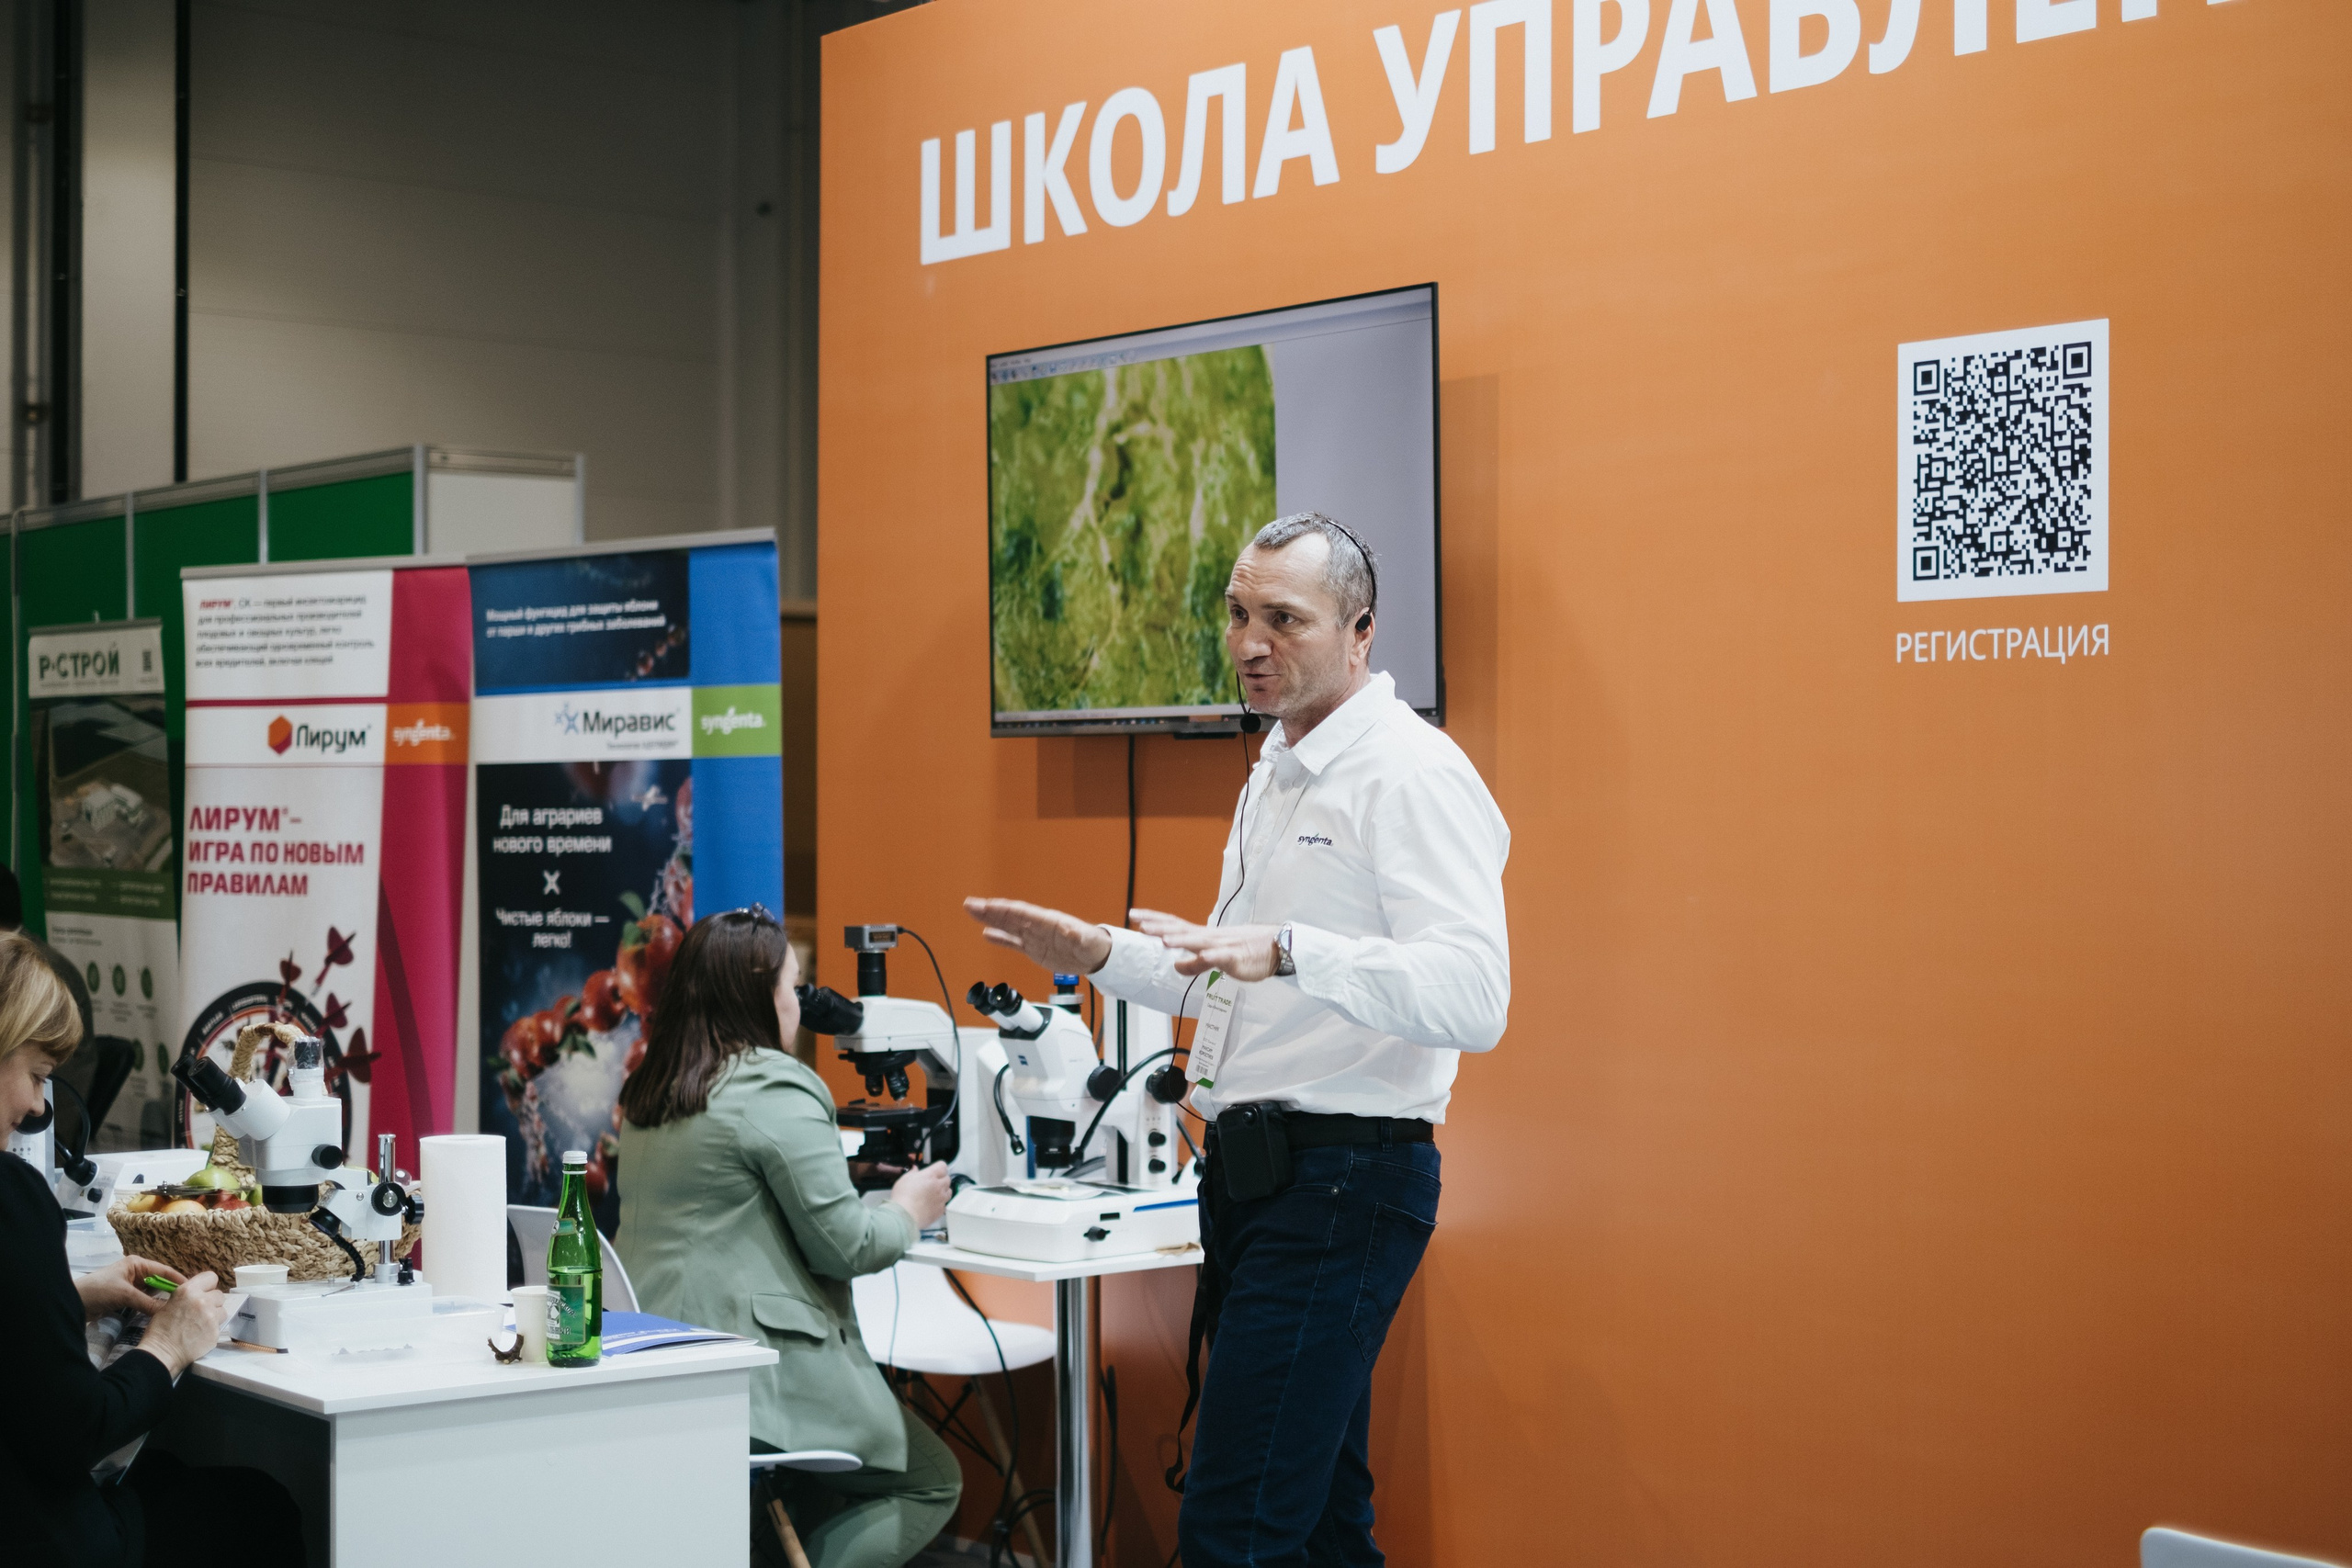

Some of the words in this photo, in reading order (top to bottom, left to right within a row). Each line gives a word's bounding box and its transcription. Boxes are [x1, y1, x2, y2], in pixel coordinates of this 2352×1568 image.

[921, 45, 1340, 265] ШКОЛА
[1373, 0, 2253, 175] УПРАВ
[1896, 624, 2109, 664] РЕГИСТРАЦИЯ
[499, 804, 529, 829] Для
[533, 807, 603, 829] аграриев
[492, 837, 544, 853] нового
[547, 836, 613, 857] времени
[1297, 833, 1333, 846] syngenta
[188, 841, 244, 863] ИГРА
[250, 841, 279, 863] ПО
[283, 842, 365, 864] НОВЫМ
[187, 872, 308, 896] ПРАВИЛАМ
[495, 907, 544, 927] Чистые
[546, 907, 593, 928] яблоки
[532, 931, 572, 949] легко!
